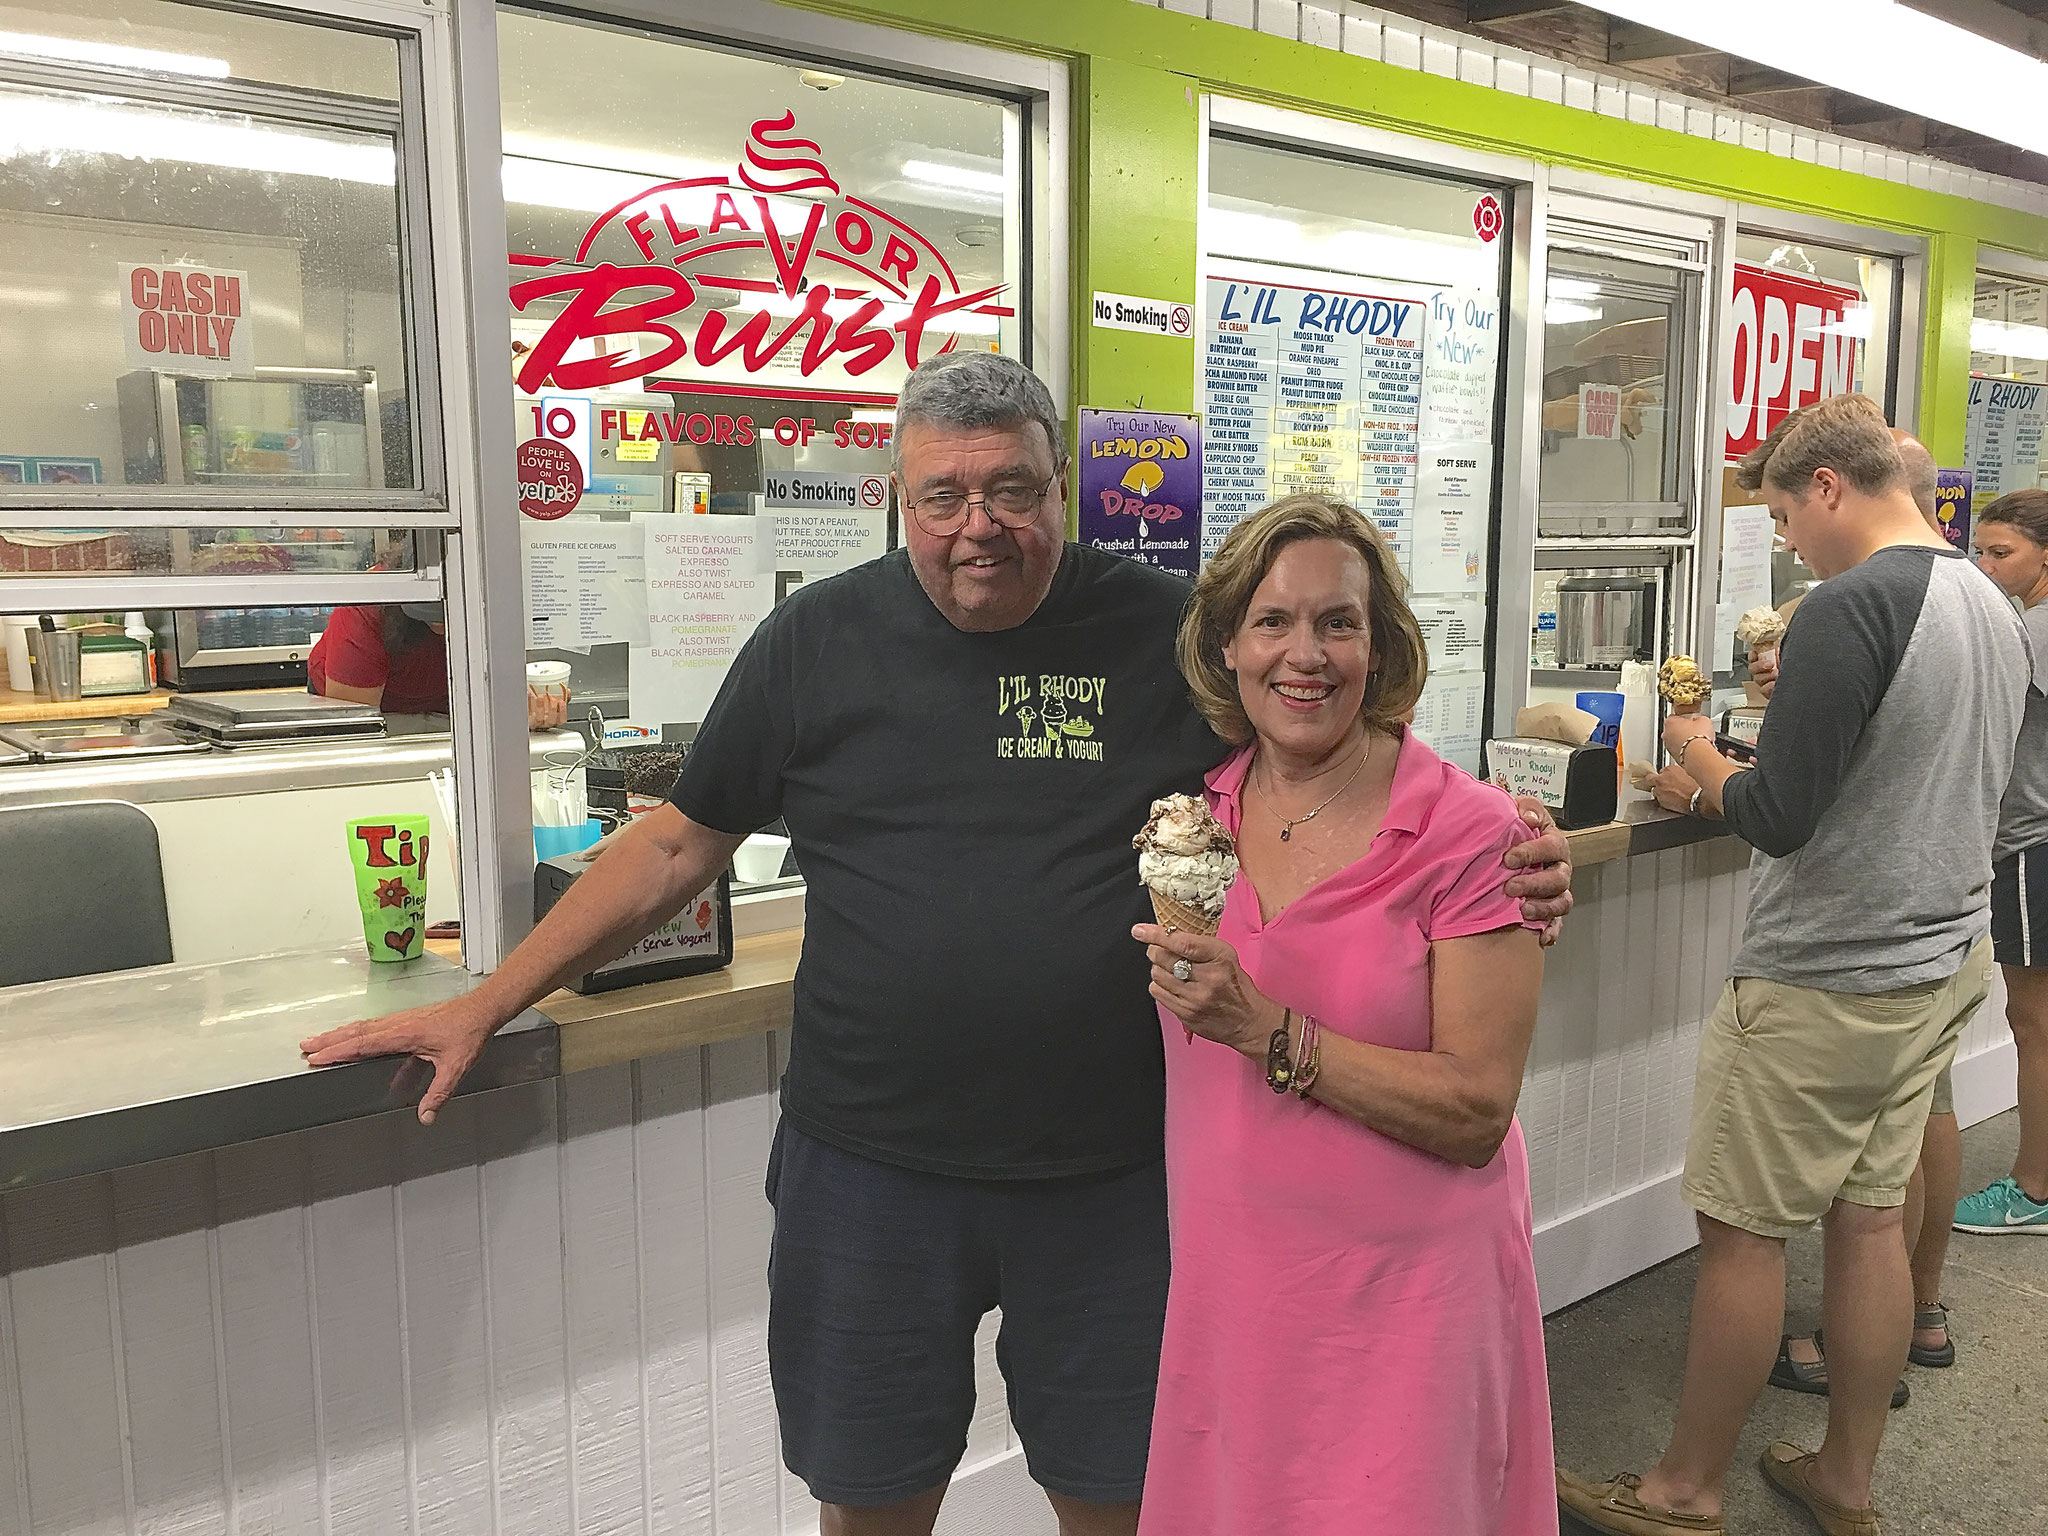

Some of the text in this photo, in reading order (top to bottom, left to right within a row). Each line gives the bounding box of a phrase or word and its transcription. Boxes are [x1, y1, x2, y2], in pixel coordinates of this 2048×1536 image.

[625, 192, 920, 300] FLAVOR
[131, 267, 241, 317] CASH
[1095, 299, 1168, 332] No Smoking
[1220, 284, 1411, 338] L'IL RHODY
[1431, 292, 1495, 332] Try Our
[508, 262, 1012, 395] Burst
[1218, 322, 1249, 332] ICE CREAM
[138, 311, 236, 357] ONLY
[1294, 331, 1334, 343] MOOSE TRACKS
[1219, 335, 1243, 345] BANANA
[1376, 337, 1415, 348] FROZEN YOGURT
[1210, 344, 1257, 356] BIRTHDAY CAKE
[1301, 343, 1314, 352] MUD
[1365, 347, 1380, 356] BLACK
[1443, 333, 1478, 364] New
[1207, 356, 1258, 369] BLACK RASPBERRY
[1289, 354, 1339, 366] ORANGE PINEAPPLE
[1727, 287, 1851, 441] OPEN
[1222, 371, 1268, 381] ALMOND FUDGE
[1307, 367, 1321, 376] OREO
[1381, 372, 1408, 381] CHOCOLATE
[1426, 366, 1486, 387] Chocolate dipped
[1208, 381, 1258, 392] BROWNIE BATTER
[1281, 377, 1344, 390] PEANUT BUTTER FUDGE
[1379, 382, 1409, 392] COFFEE CHIP
[1432, 383, 1458, 394] waffle
[1214, 394, 1250, 404] BUBBLE GUM
[1282, 388, 1342, 401] PEANUT BUTTER OREO
[1369, 392, 1418, 404] CHOCOLATE ALMOND
[1969, 381, 2040, 411] IL RHODY
[1586, 389, 1618, 416] CASH
[1209, 405, 1254, 417] BUTTER CRUNCH
[1389, 406, 1415, 415] CHOCOLATE
[531, 406, 576, 439] 10
[600, 409, 755, 446] FLAVORS
[774, 417, 816, 447] OF
[834, 419, 891, 449] SOF
[1107, 417, 1177, 435] Try Our New
[1209, 418, 1251, 428] BUTTER PECAN
[1586, 415, 1616, 438] ONLY
[1212, 430, 1250, 440] CAKE BATTER
[528, 446, 565, 460] PEOPLE
[1091, 436, 1190, 460] LEMON
[521, 455, 571, 472] LOVE US
[1243, 456, 1256, 464] CHIP
[1437, 459, 1477, 468] SOFT SERVE
[540, 470, 552, 478] ON
[1243, 467, 1266, 476] CRUNCH
[1374, 466, 1390, 474] COFFEE
[1208, 478, 1254, 488] CHERRY VANILLA
[518, 480, 556, 503] yelp
[766, 478, 857, 507] No Smoking
[1937, 485, 1966, 500] MON
[1223, 493, 1266, 502] MOOSE TRACKS
[1100, 490, 1184, 525] DROP
[1215, 503, 1247, 512] CHOCOLATE
[776, 517, 859, 527] HIS IS NOT A PEANUT,
[790, 528, 870, 538] TREE, SOY, MILK AND
[654, 535, 754, 545] SOFT SERVE YOGURTS
[801, 539, 862, 548] PRODUCT FREE
[1092, 538, 1190, 550] Crushed Lemonade
[531, 542, 558, 550] GLUTEN
[665, 546, 744, 556] SALTED CARAMEL
[786, 550, 839, 559] CREAM SHOP
[680, 558, 730, 567] EXPRESSO
[678, 569, 732, 578] ALSO TWIST
[651, 581, 701, 589] EXPRESSO
[703, 581, 722, 589] AND
[723, 580, 755, 589] SALTED
[683, 592, 726, 600] CARAMEL
[650, 613, 756, 623] BLACK RASPBERRY AND
[671, 625, 737, 634] POMEGRANATE
[679, 637, 731, 646] ALSO TWIST
[651, 647, 737, 657] BLACK RASPBERRY
[999, 675, 1106, 716] L'IL RHODY
[1734, 719, 1761, 730] Welco
[605, 729, 659, 739] HORIZON
[998, 737, 1103, 762] ICE CREAM & YOGURT
[1496, 742, 1532, 757] Welcome
[1529, 761, 1556, 777] Rhody!
[1532, 776, 1550, 786] New
[1517, 786, 1538, 798] Serve
[643, 932, 712, 954] Serve Yogurt!
